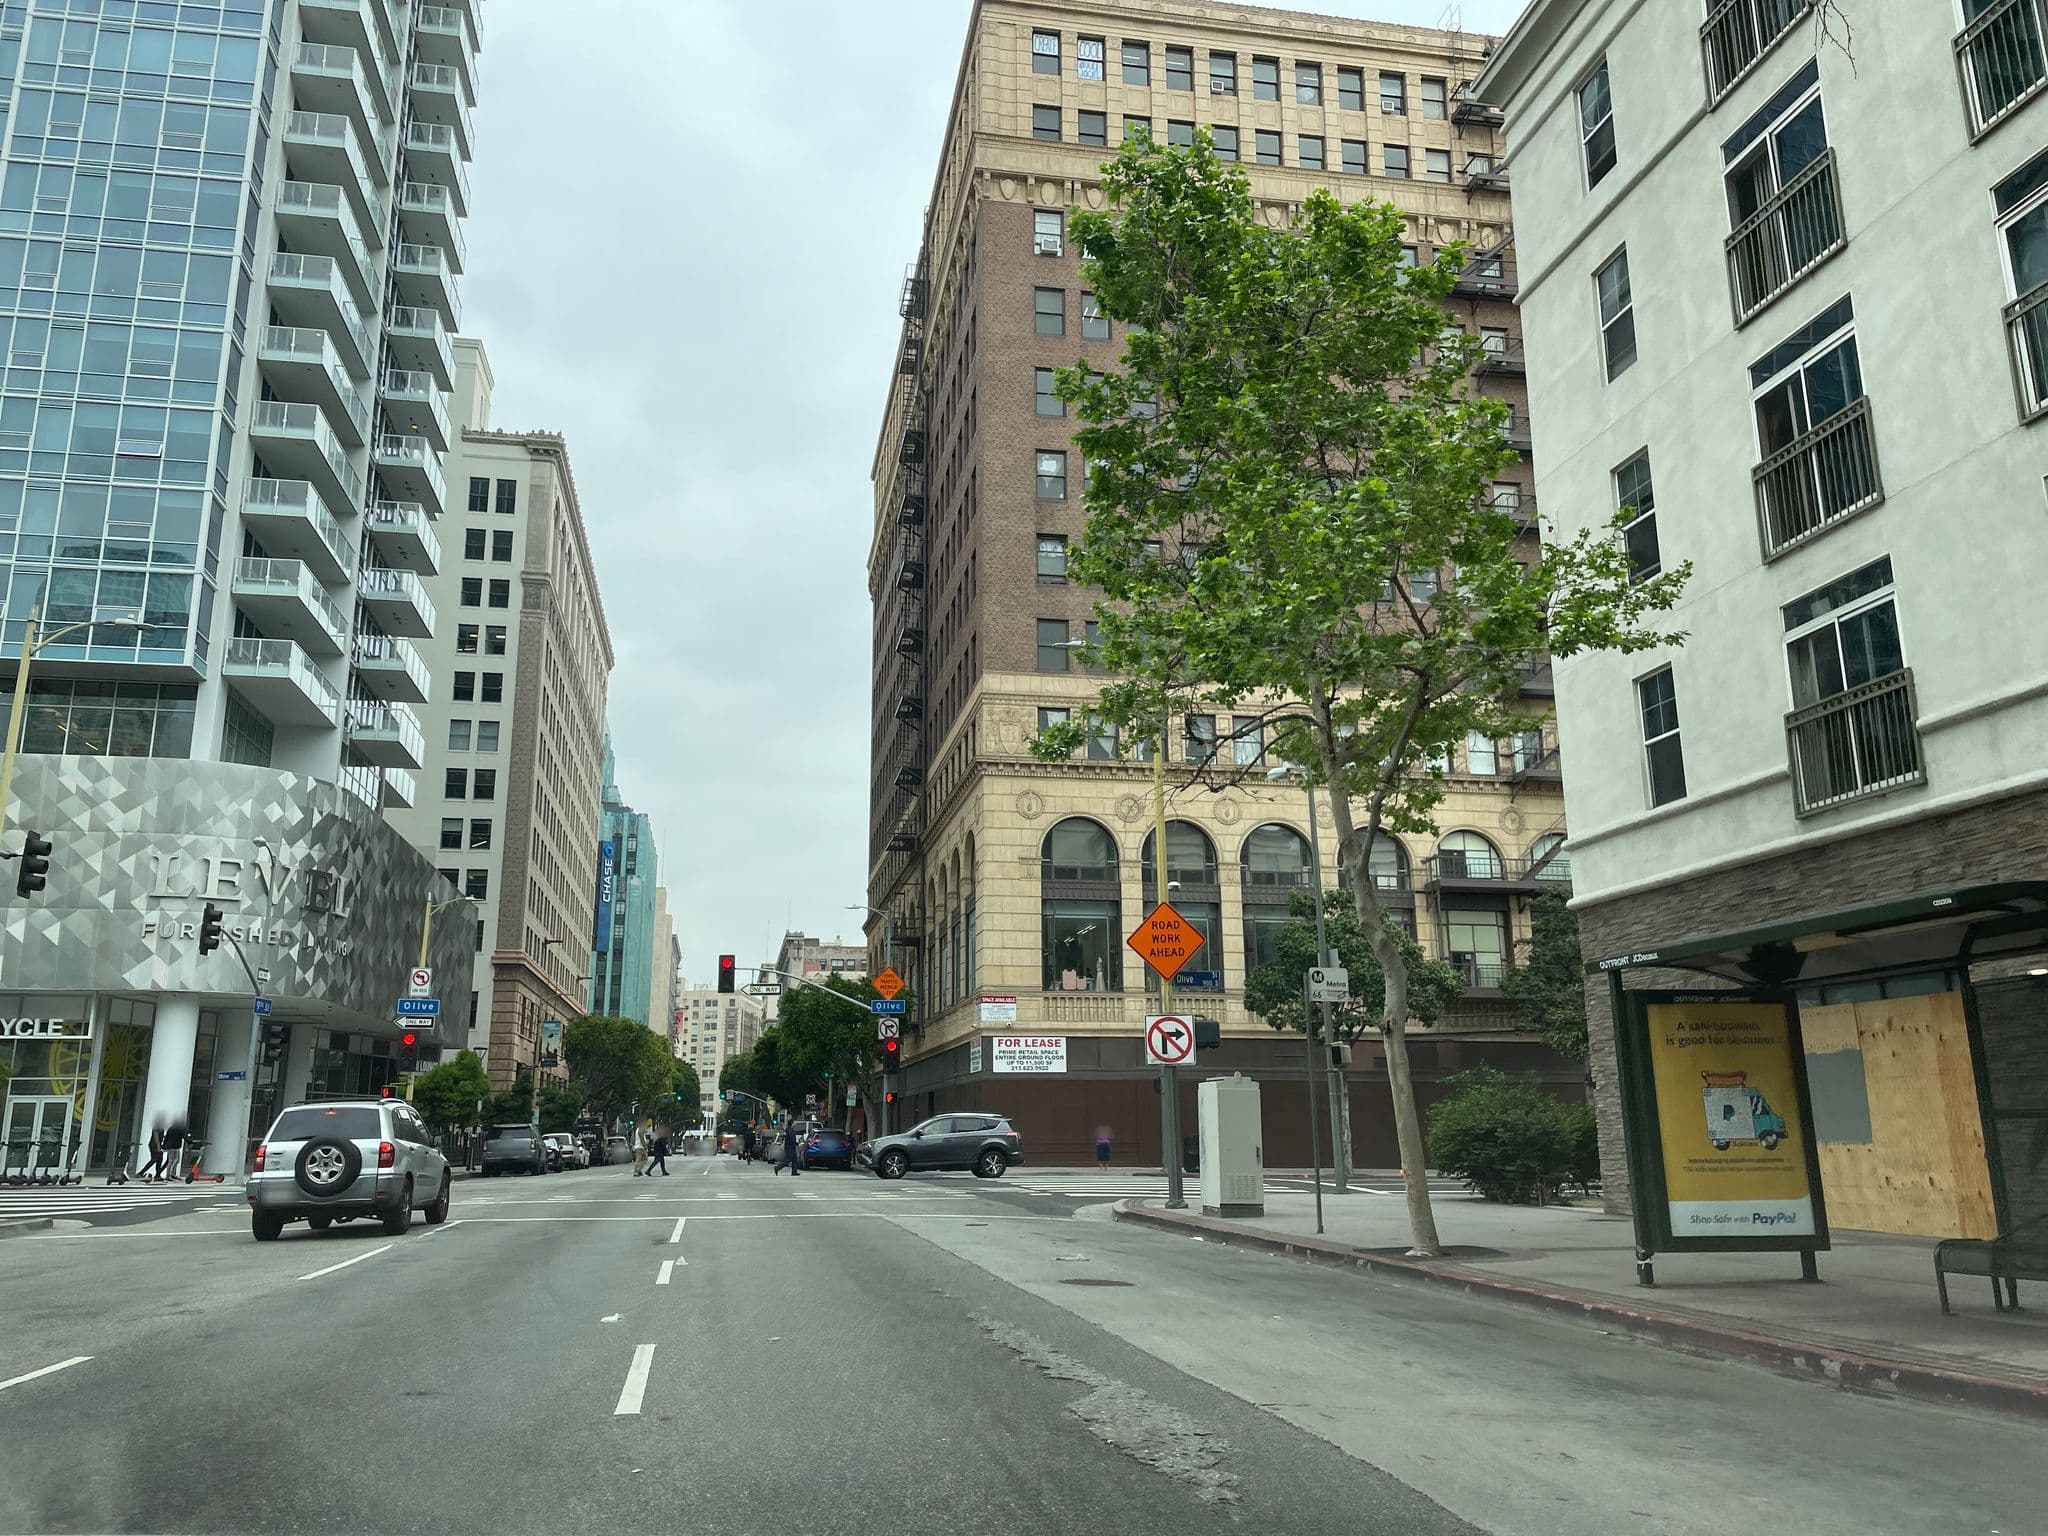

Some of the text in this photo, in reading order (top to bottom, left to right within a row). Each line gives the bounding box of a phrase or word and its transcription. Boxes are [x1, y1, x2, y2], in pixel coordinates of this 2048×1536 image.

[602, 858, 612, 902] CHASE
[148, 856, 349, 918] LEVEL
[1152, 921, 1180, 930] ROAD
[141, 922, 293, 946] FURISHED
[1152, 934, 1180, 943] WORK
[1150, 948, 1185, 957] AHEAD
[1599, 956, 1629, 969] OUTFRONT
[1176, 974, 1194, 984] Olive
[404, 1002, 434, 1010] Olive
[876, 1002, 900, 1010] Olive
[1677, 1022, 1685, 1031] A
[998, 1038, 1062, 1048] FOR LEASE
[1752, 1212, 1796, 1226] PayPal
